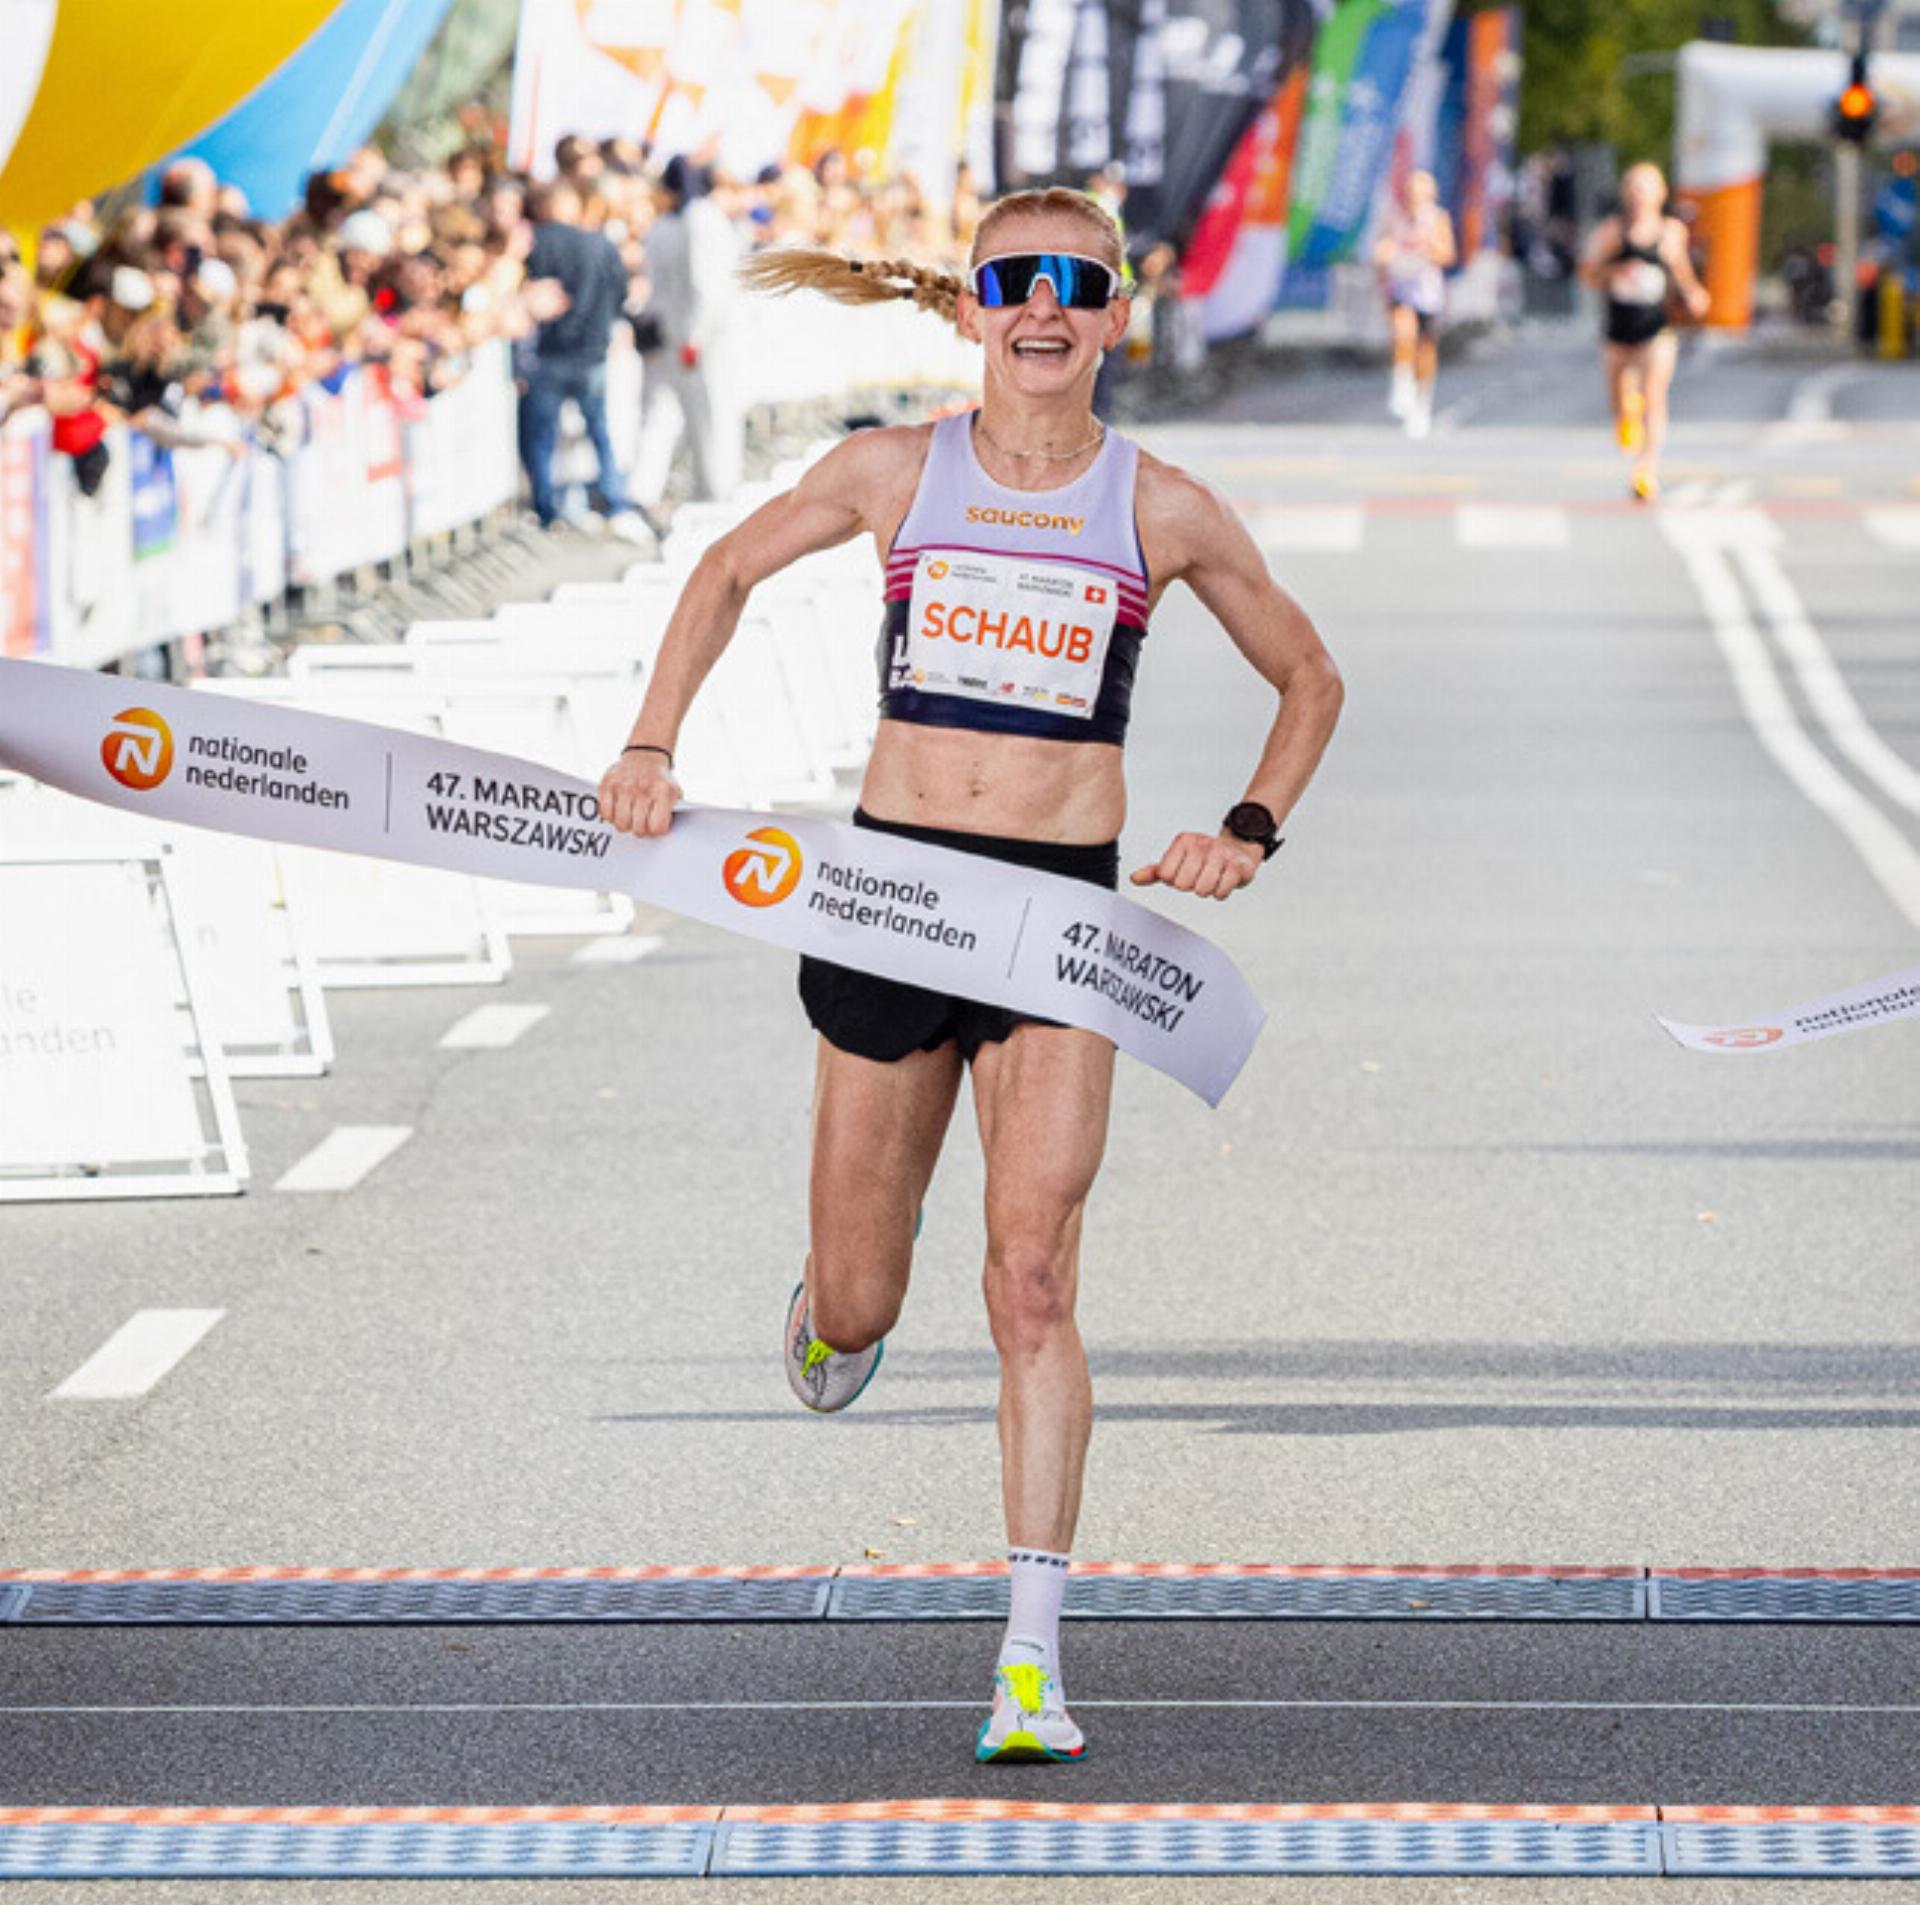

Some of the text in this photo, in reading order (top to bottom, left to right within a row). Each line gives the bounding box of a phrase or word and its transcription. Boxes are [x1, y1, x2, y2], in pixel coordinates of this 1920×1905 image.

[966, 506, 1086, 536] saucony
[921, 602, 1094, 664] SCHAUB
[189, 735, 308, 774] nationale
[186, 765, 350, 810] nederlanden
[426, 772, 604, 824] 47. MARATO
[426, 803, 613, 858] WARSZAWSKI
[816, 861, 940, 910] nationale
[808, 890, 977, 951] nederlanden
[1061, 921, 1205, 1002] 47. MARATON
